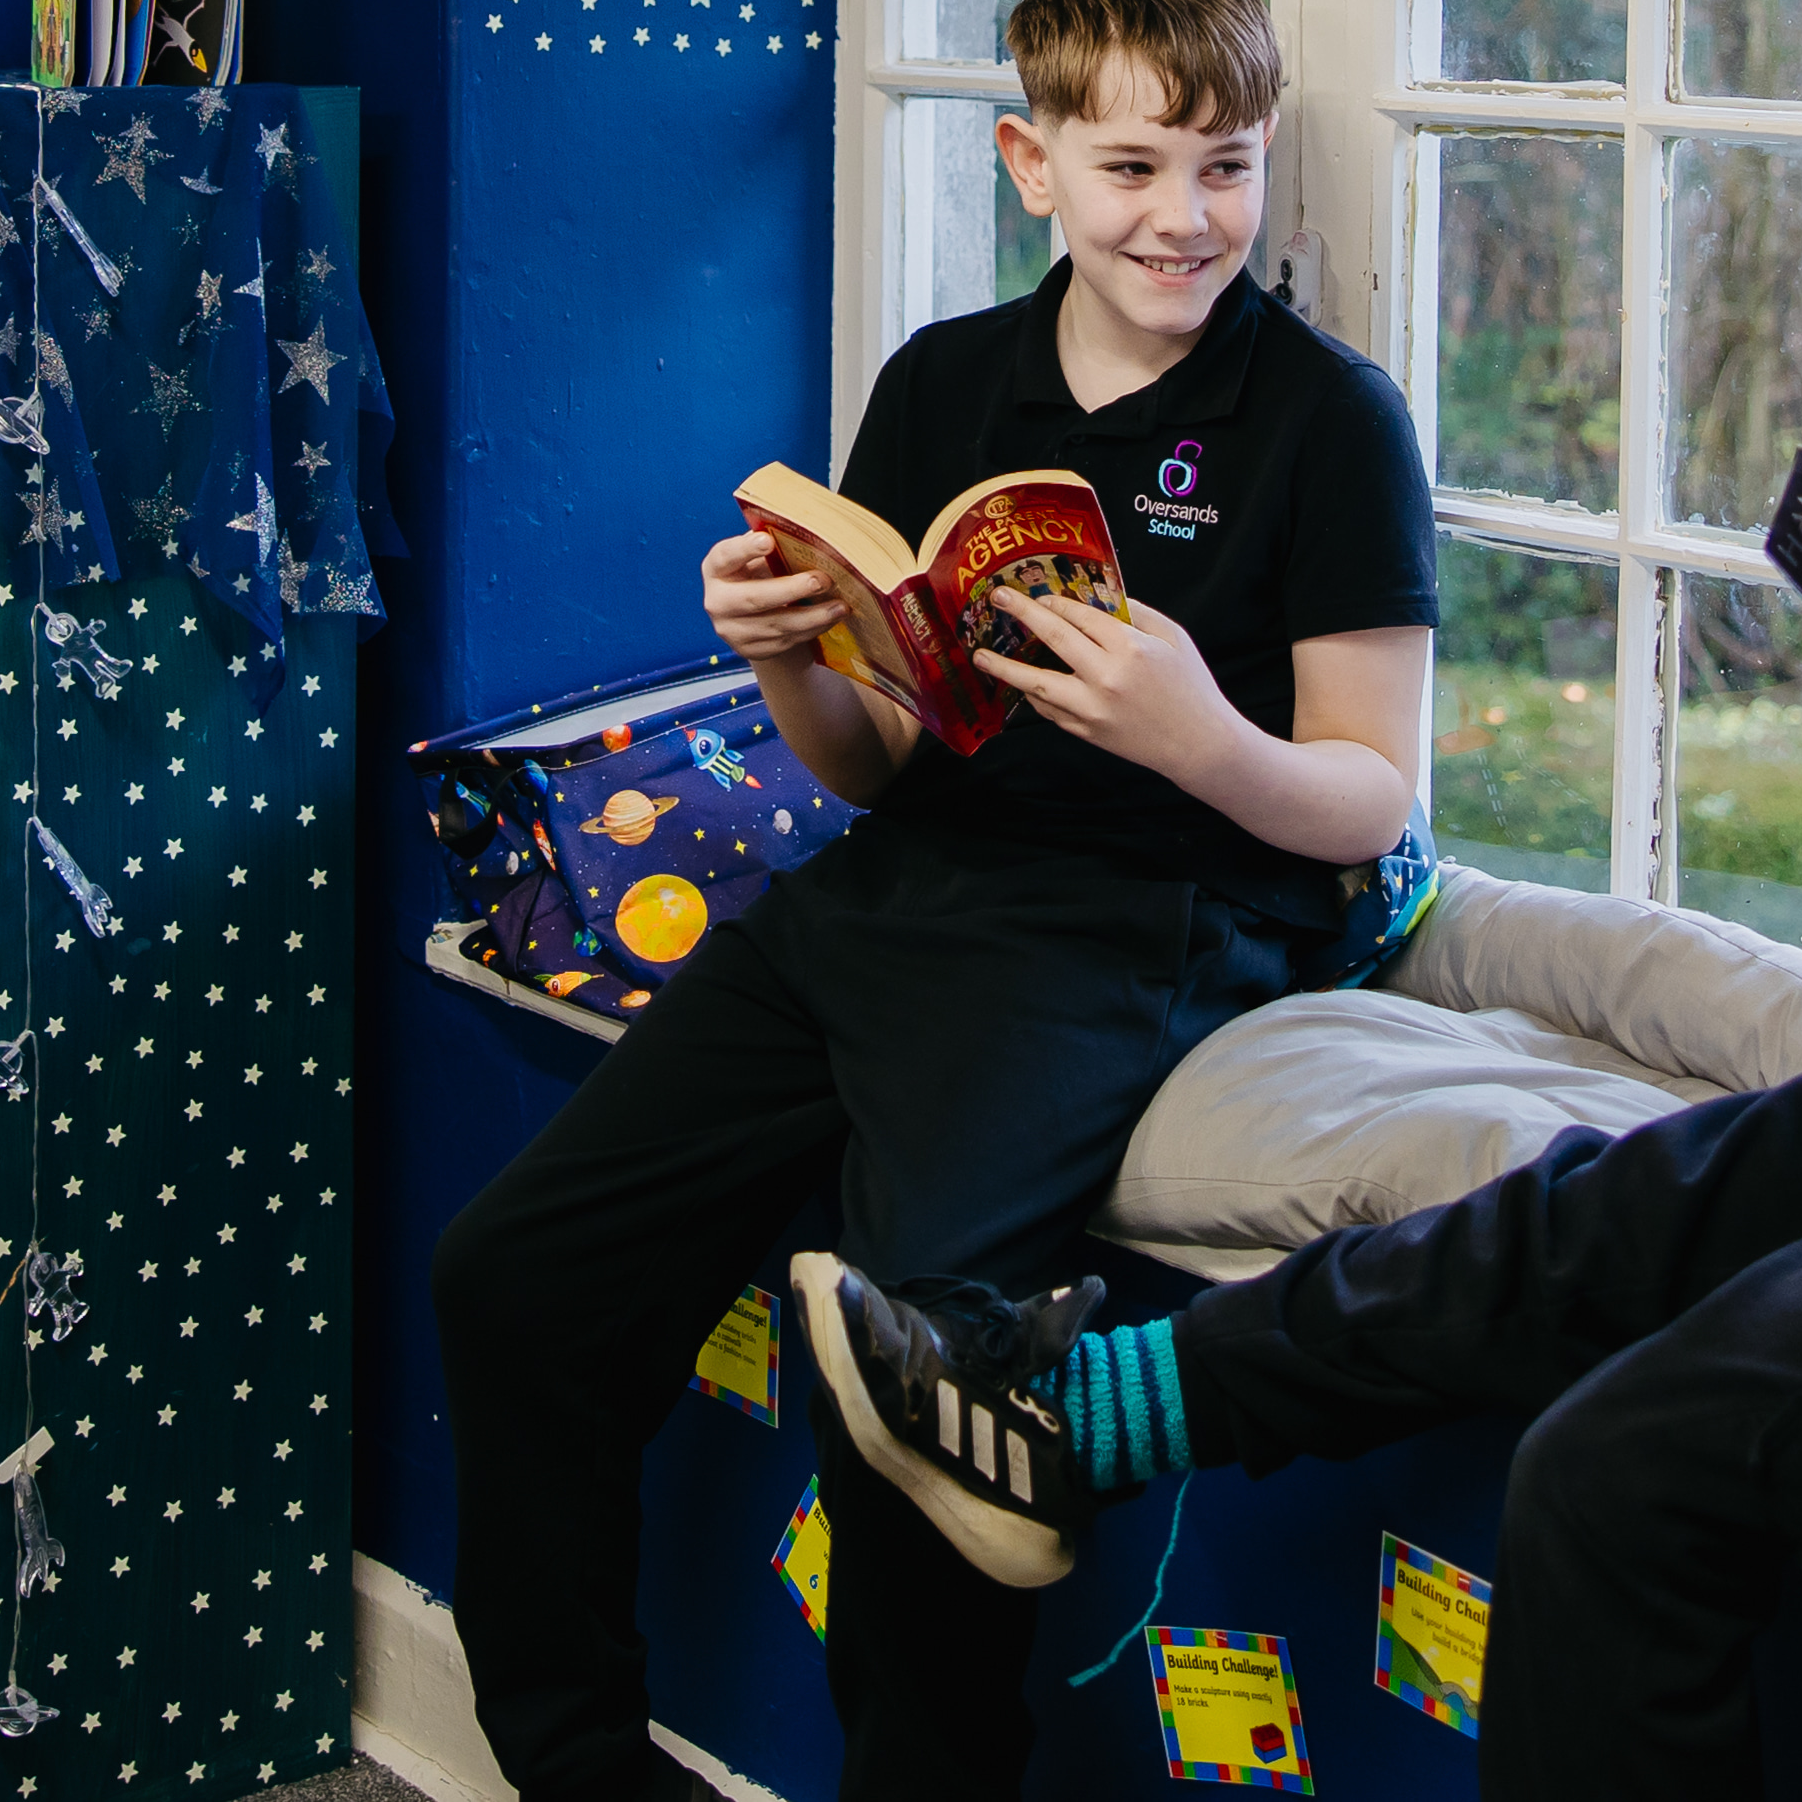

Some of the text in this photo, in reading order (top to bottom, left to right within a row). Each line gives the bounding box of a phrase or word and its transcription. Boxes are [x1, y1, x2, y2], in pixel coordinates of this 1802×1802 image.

[1134, 494, 1218, 524] Oversands
[965, 510, 1056, 551] THE PARENT
[1148, 518, 1196, 540] School
[957, 519, 1084, 595] AGENCY
[899, 592, 933, 641] AGENCY
[809, 1574, 819, 1590] 6
[1398, 1568, 1486, 1626] Building Chal
[1167, 1654, 1279, 1681] Building Challenge!
[1174, 1684, 1192, 1694] Make
[1200, 1686, 1231, 1697] sculpture
[1233, 1689, 1250, 1701] using
[1252, 1693, 1272, 1704] exactly
[1177, 1697, 1186, 1706] 18
